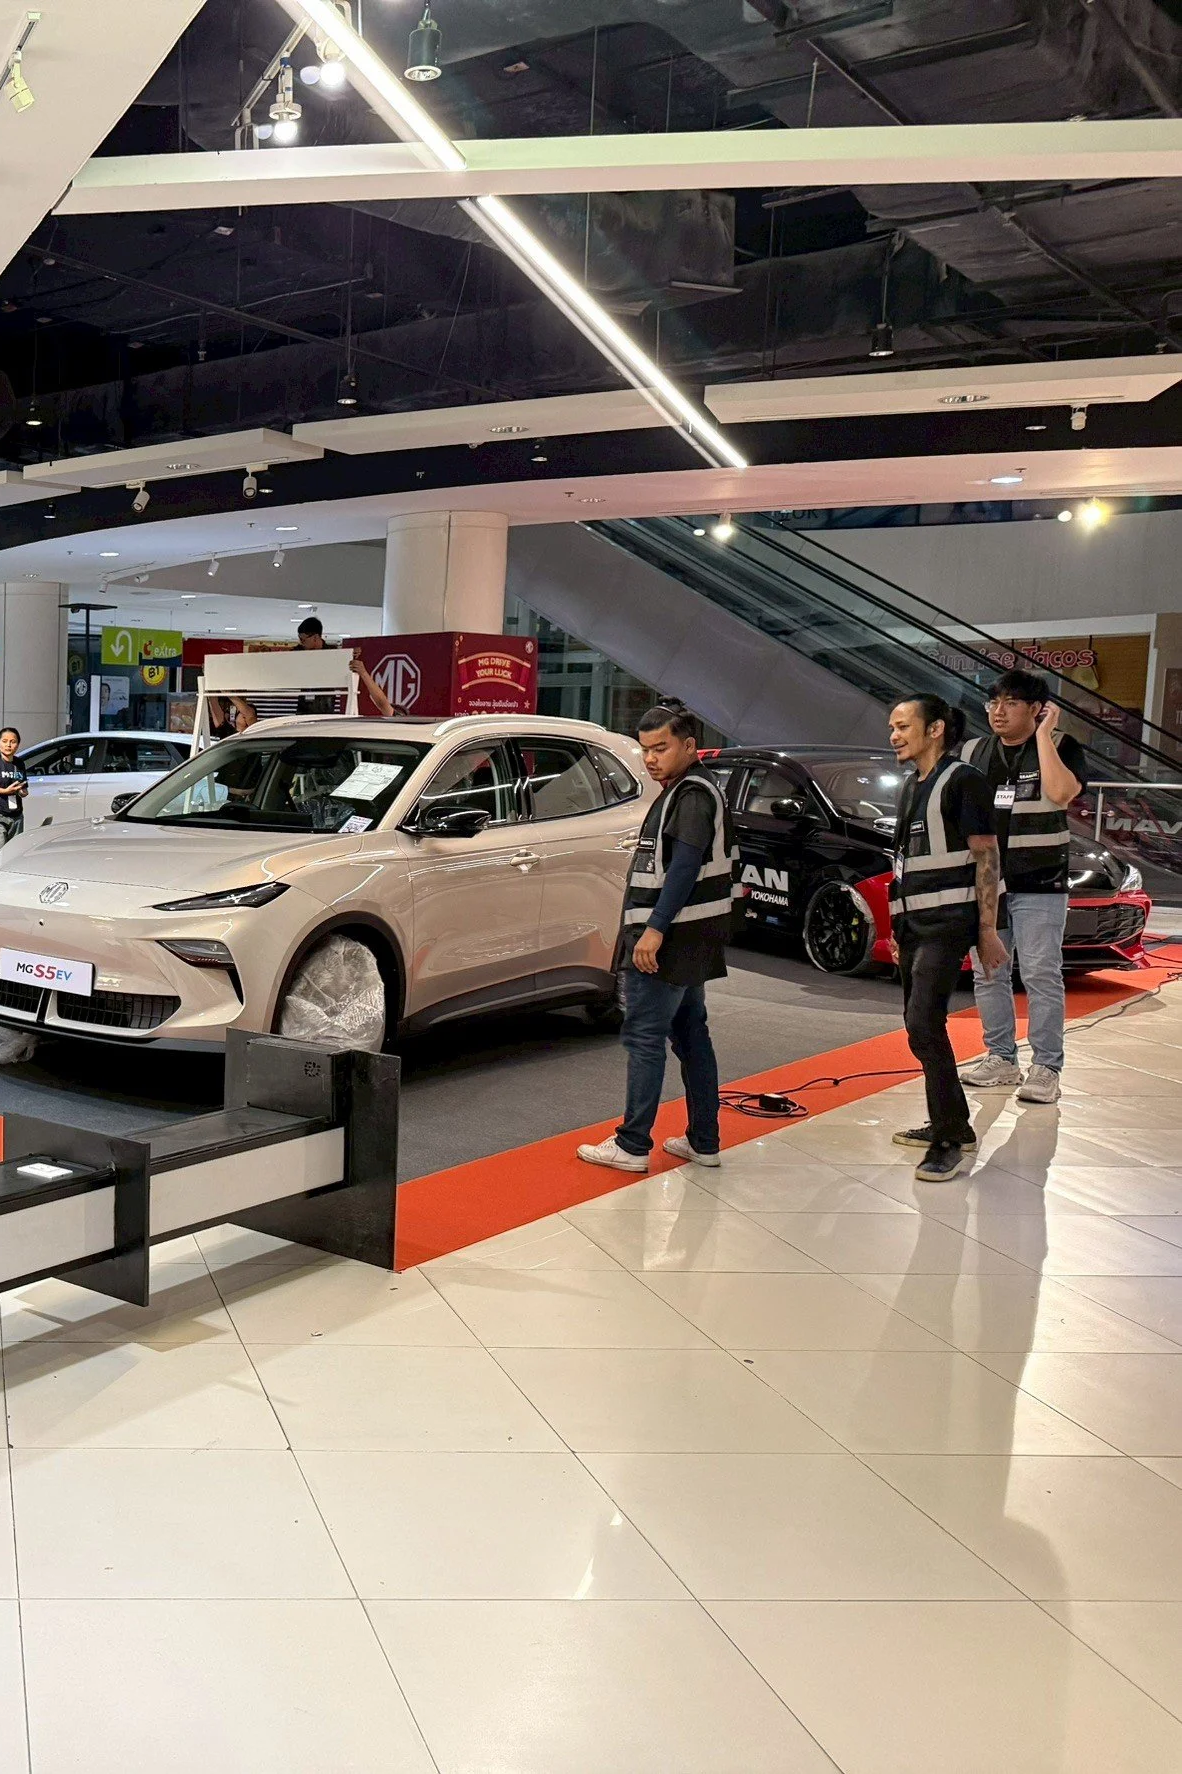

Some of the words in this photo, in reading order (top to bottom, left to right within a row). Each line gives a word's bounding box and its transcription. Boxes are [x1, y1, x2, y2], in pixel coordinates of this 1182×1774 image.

[154, 643, 177, 657] extra
[1022, 645, 1095, 668] Tacos
[478, 658, 489, 667] MG
[490, 657, 511, 668] DRIVE
[476, 668, 494, 678] YOUR
[494, 668, 512, 680] LUCK
[374, 658, 417, 711] MG
[739, 863, 789, 892] AN
[750, 889, 789, 907] YOKOHAMA
